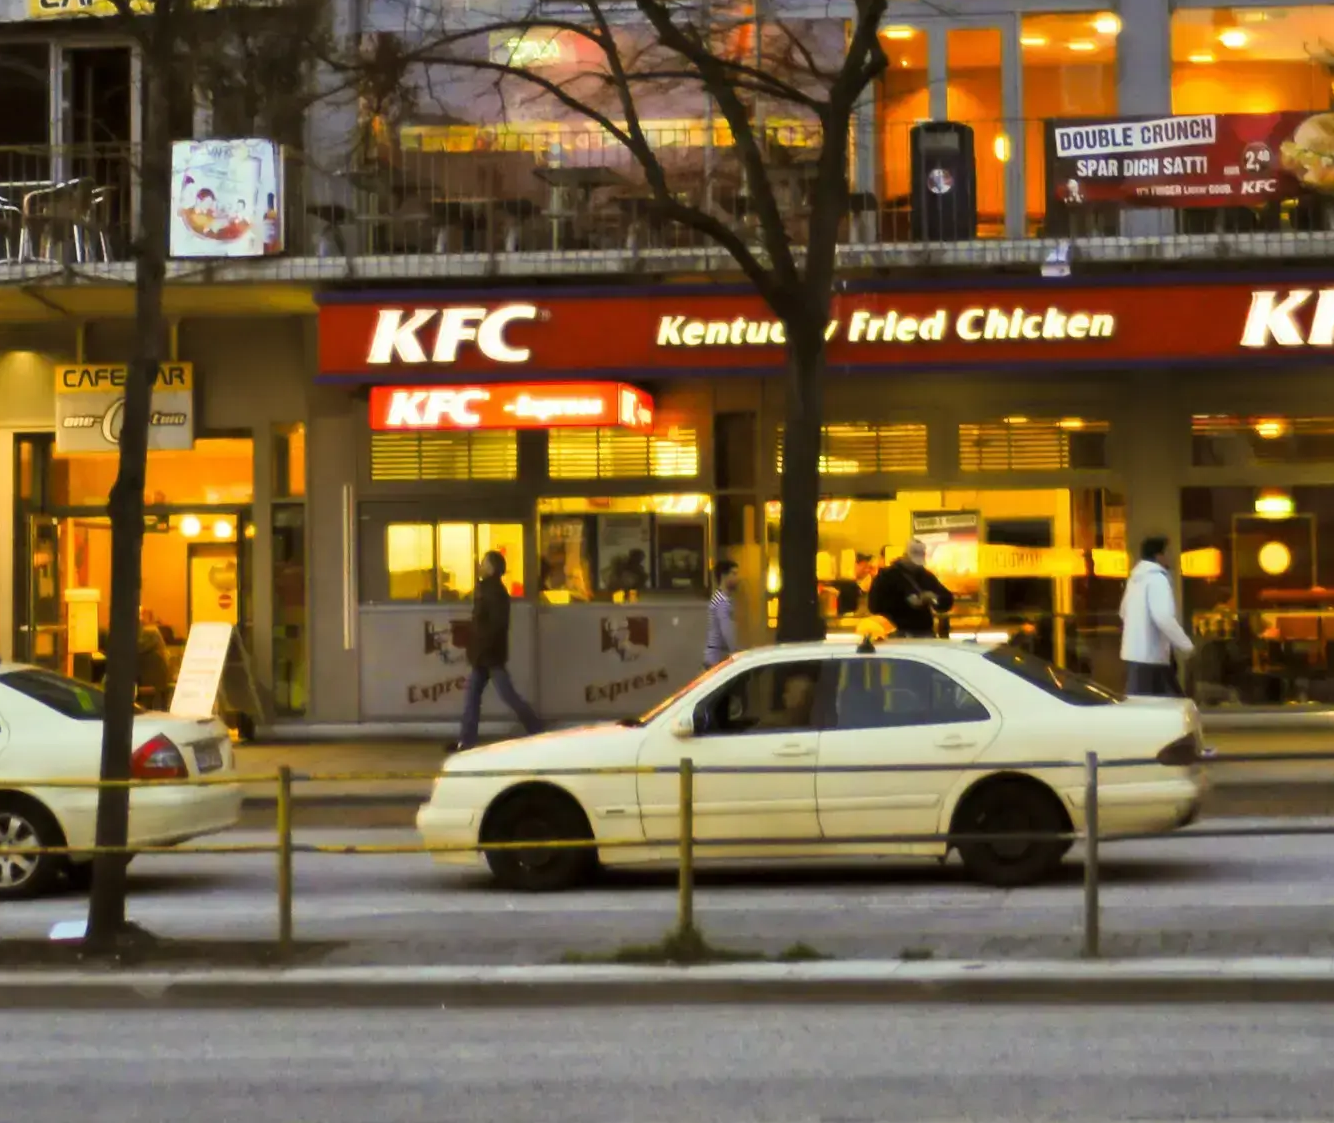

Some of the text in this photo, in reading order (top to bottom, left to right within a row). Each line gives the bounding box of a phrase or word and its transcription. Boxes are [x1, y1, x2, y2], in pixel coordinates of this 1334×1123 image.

[1059, 118, 1213, 152] DOUBLE CRUNCH
[1077, 158, 1119, 177] SPAR
[1124, 156, 1159, 176] DICH
[1241, 179, 1277, 195] KFC
[366, 301, 537, 364] KFC
[656, 305, 1115, 346] Kentuc Fried Chicken
[63, 368, 126, 388] CAFE
[386, 388, 491, 426] KFC
[407, 675, 467, 704] Expre
[583, 666, 668, 704] Express
